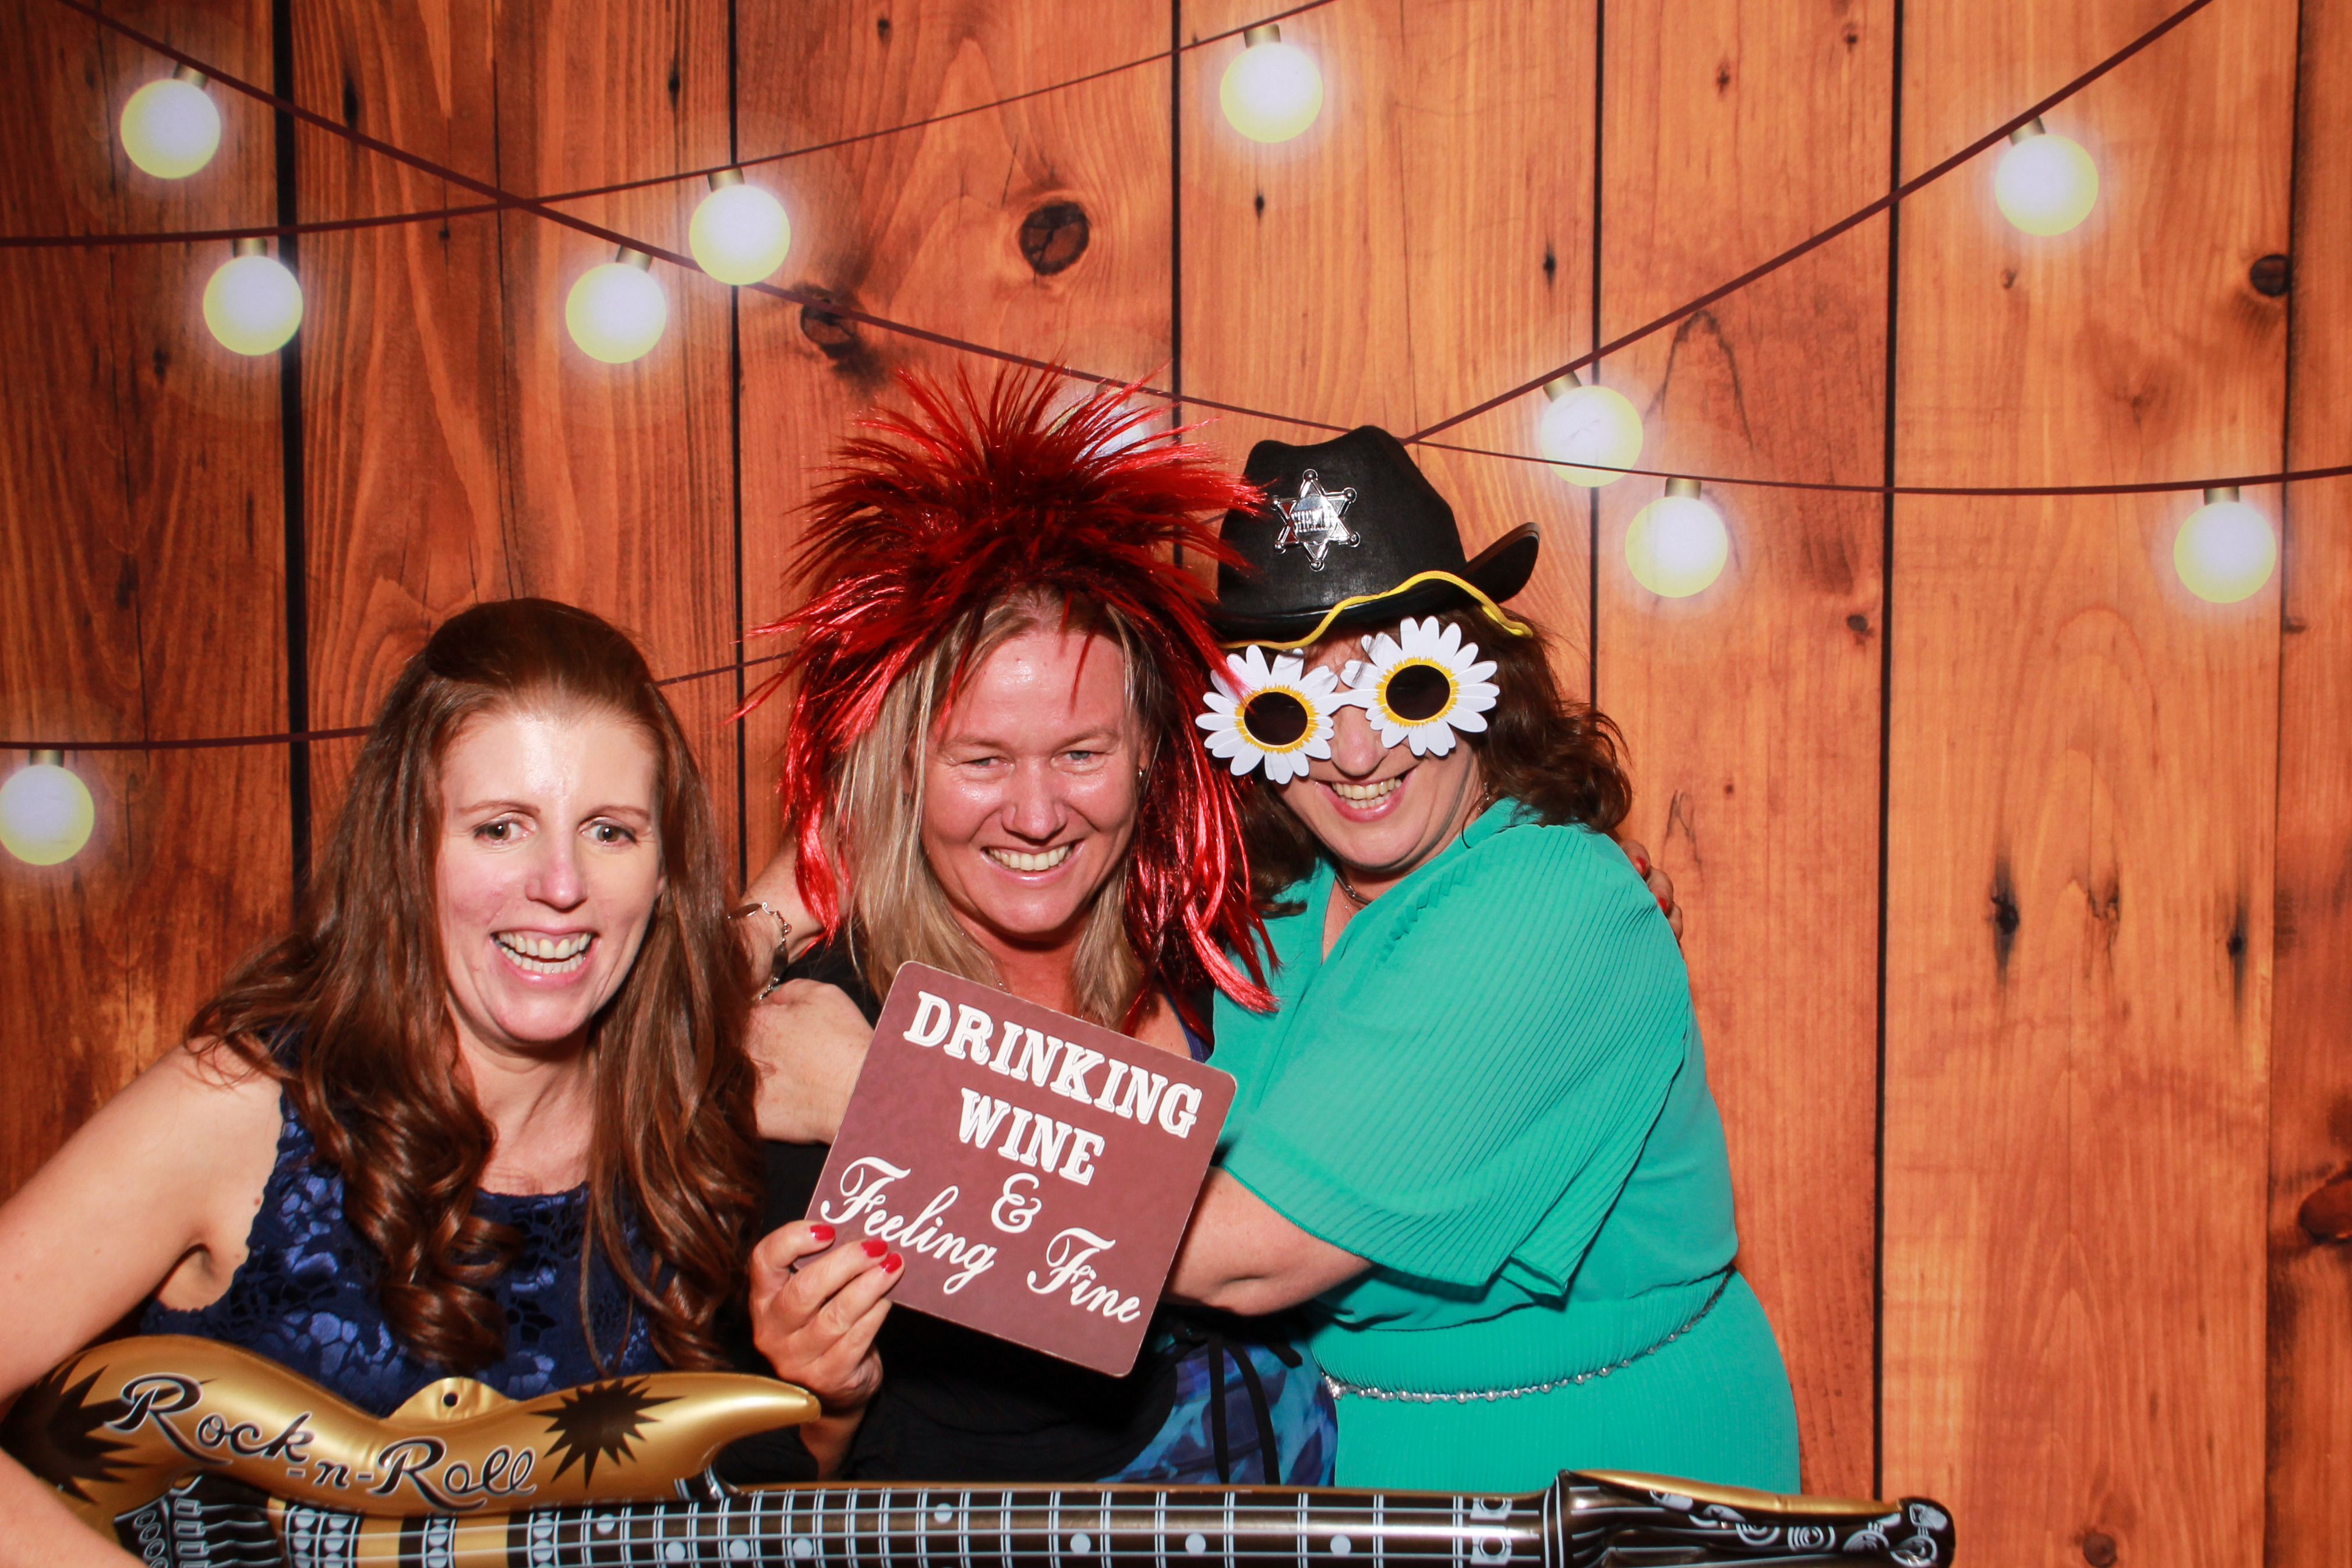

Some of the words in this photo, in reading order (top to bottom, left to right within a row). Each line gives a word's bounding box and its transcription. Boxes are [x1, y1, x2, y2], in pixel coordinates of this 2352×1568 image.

[902, 990, 1203, 1139] DRINKING
[958, 1087, 1106, 1186] WINE
[820, 1156, 998, 1295] Feeling
[1027, 1227, 1140, 1323] Fine
[991, 1173, 1042, 1234] &
